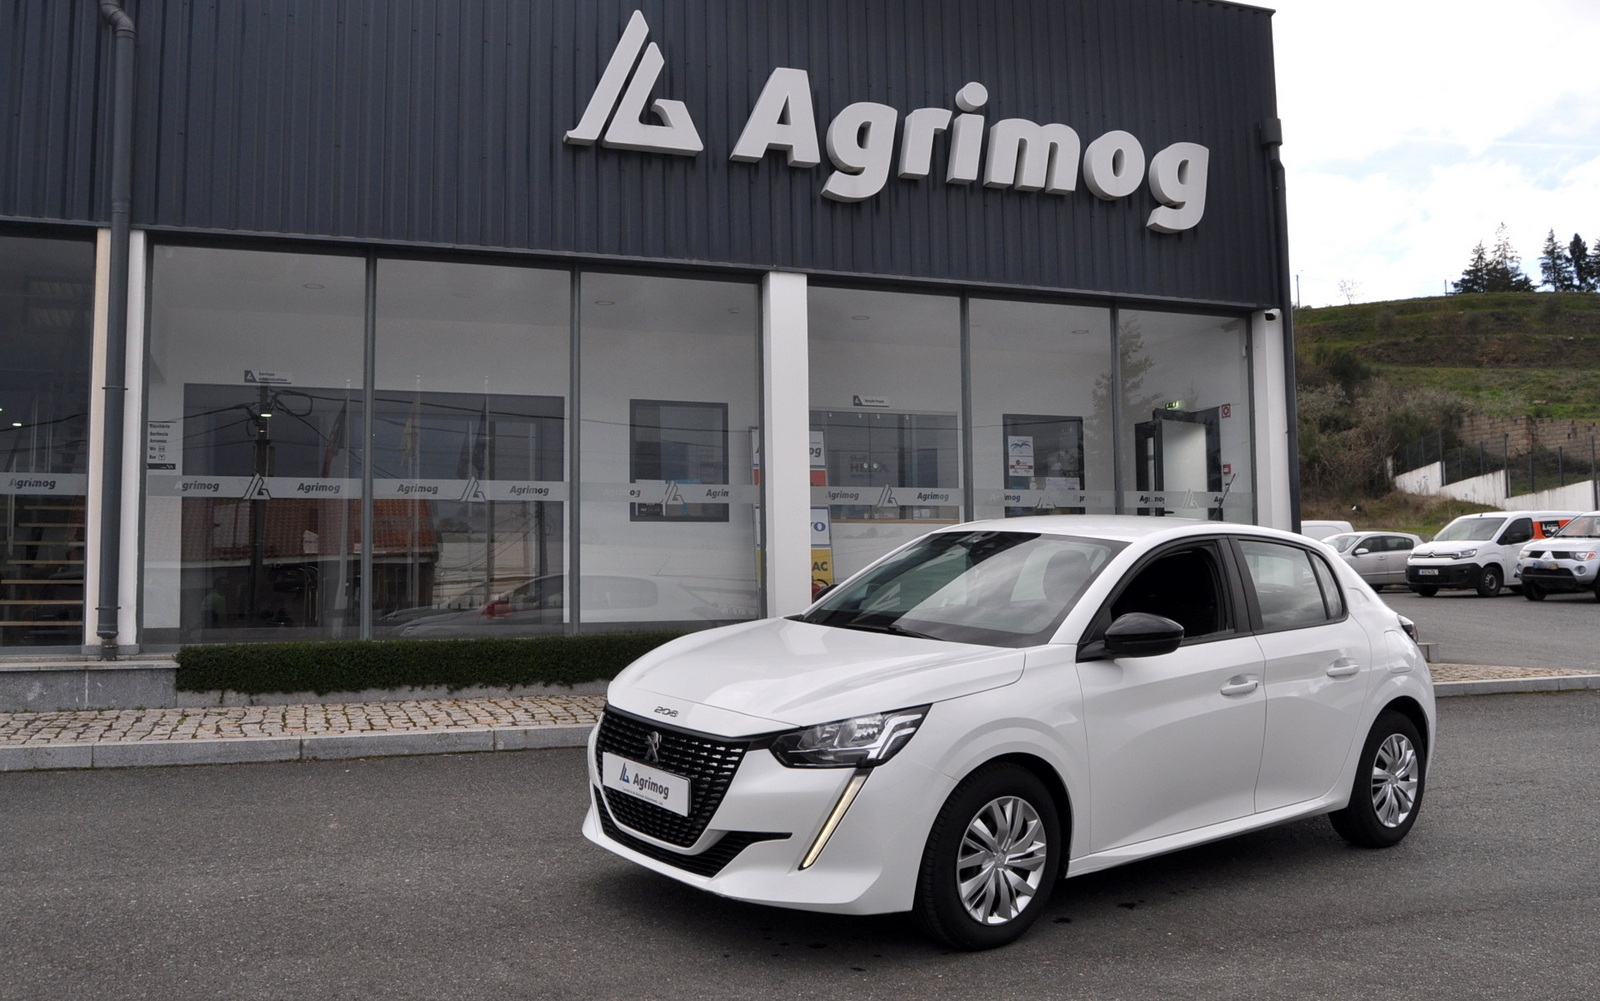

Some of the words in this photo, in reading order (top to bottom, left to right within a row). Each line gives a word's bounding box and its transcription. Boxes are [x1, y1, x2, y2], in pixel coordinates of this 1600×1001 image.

[729, 66, 1210, 233] Agrimog
[8, 477, 57, 490] Agrimog
[174, 480, 220, 492] Agrimog
[297, 482, 341, 494] Agrimog
[397, 483, 439, 495] Agrimog
[509, 485, 550, 497] Agrimog
[917, 492, 950, 501] Agrimog
[633, 772, 670, 800] Agrimog
